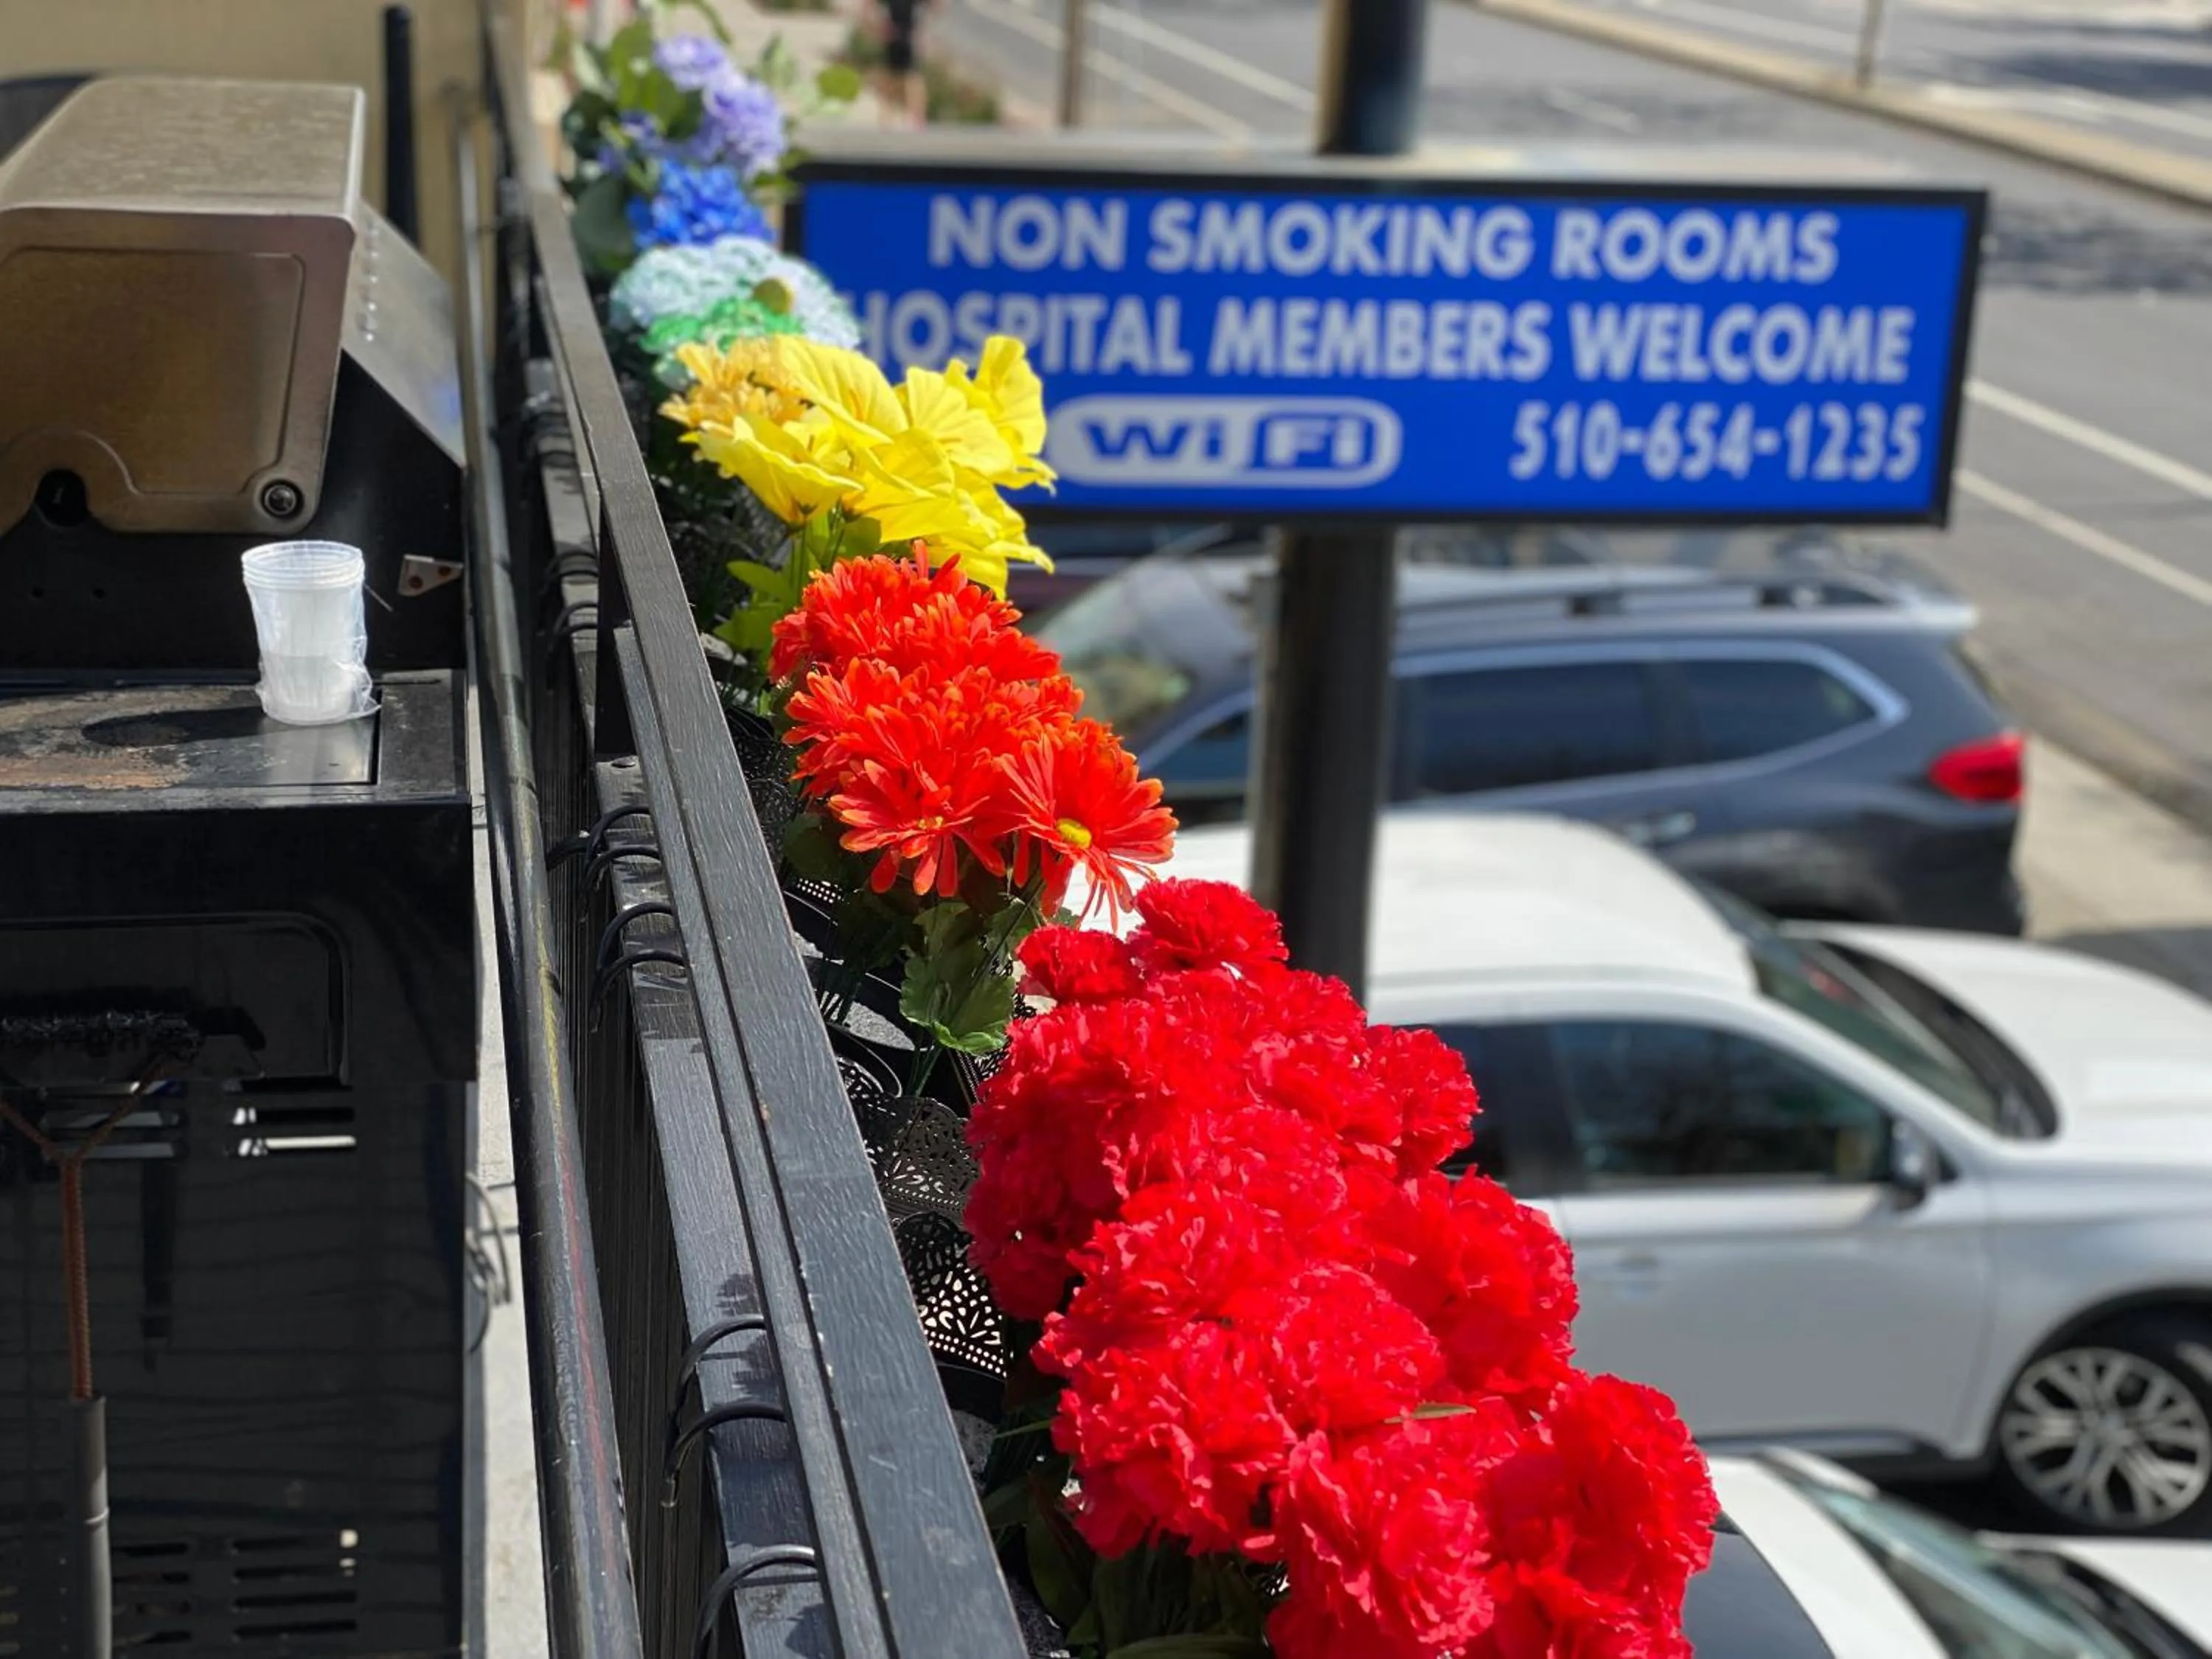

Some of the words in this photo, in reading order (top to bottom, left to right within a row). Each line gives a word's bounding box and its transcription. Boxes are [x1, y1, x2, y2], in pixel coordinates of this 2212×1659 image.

[929, 196, 1127, 271] NON
[1148, 201, 1535, 279] SMOKING
[1552, 209, 1840, 284] ROOMS
[1208, 299, 1552, 380] MEMBERS
[1568, 302, 1916, 384] WELCOME
[1509, 399, 1925, 482] 510-654-1235
